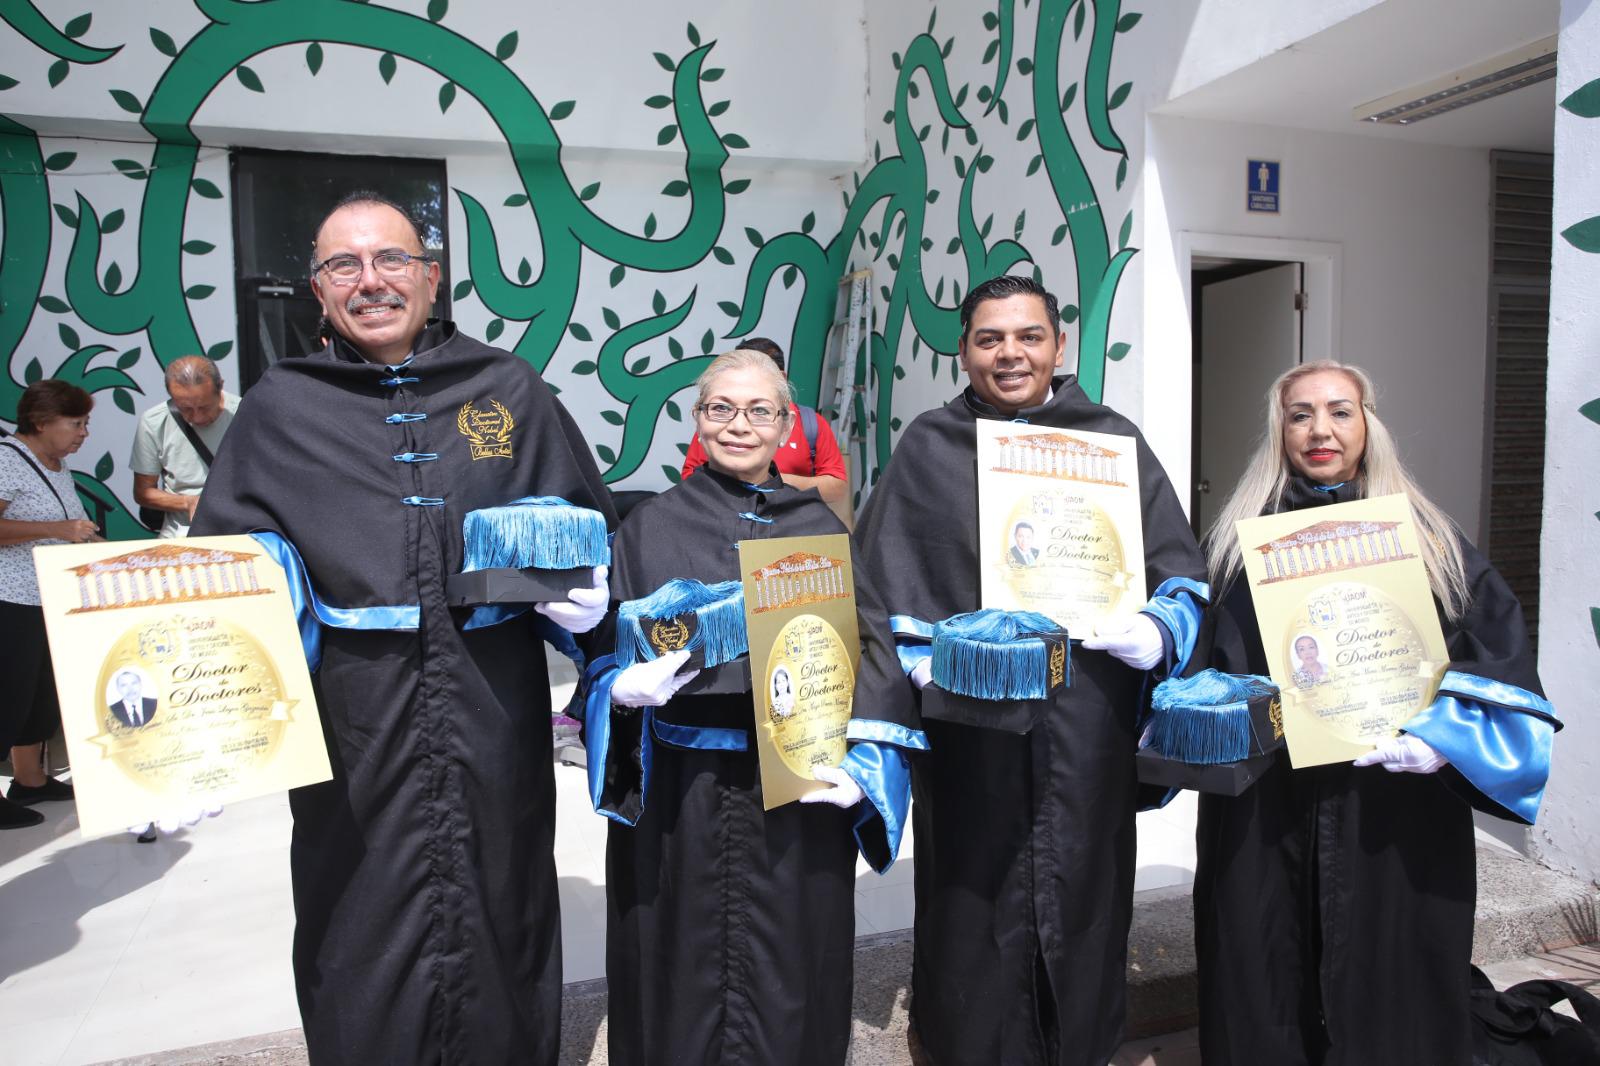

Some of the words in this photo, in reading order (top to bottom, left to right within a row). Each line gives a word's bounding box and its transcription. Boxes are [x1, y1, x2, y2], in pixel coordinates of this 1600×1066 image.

[1049, 525, 1102, 543] Doctor
[1047, 543, 1109, 561] Doctores
[1336, 626, 1397, 647] Doctor
[1336, 645, 1409, 667] Doctores
[172, 660, 249, 684] Doctor
[801, 660, 838, 680] Doctor
[169, 684, 262, 708] Doctores
[800, 681, 845, 701] Doctores
